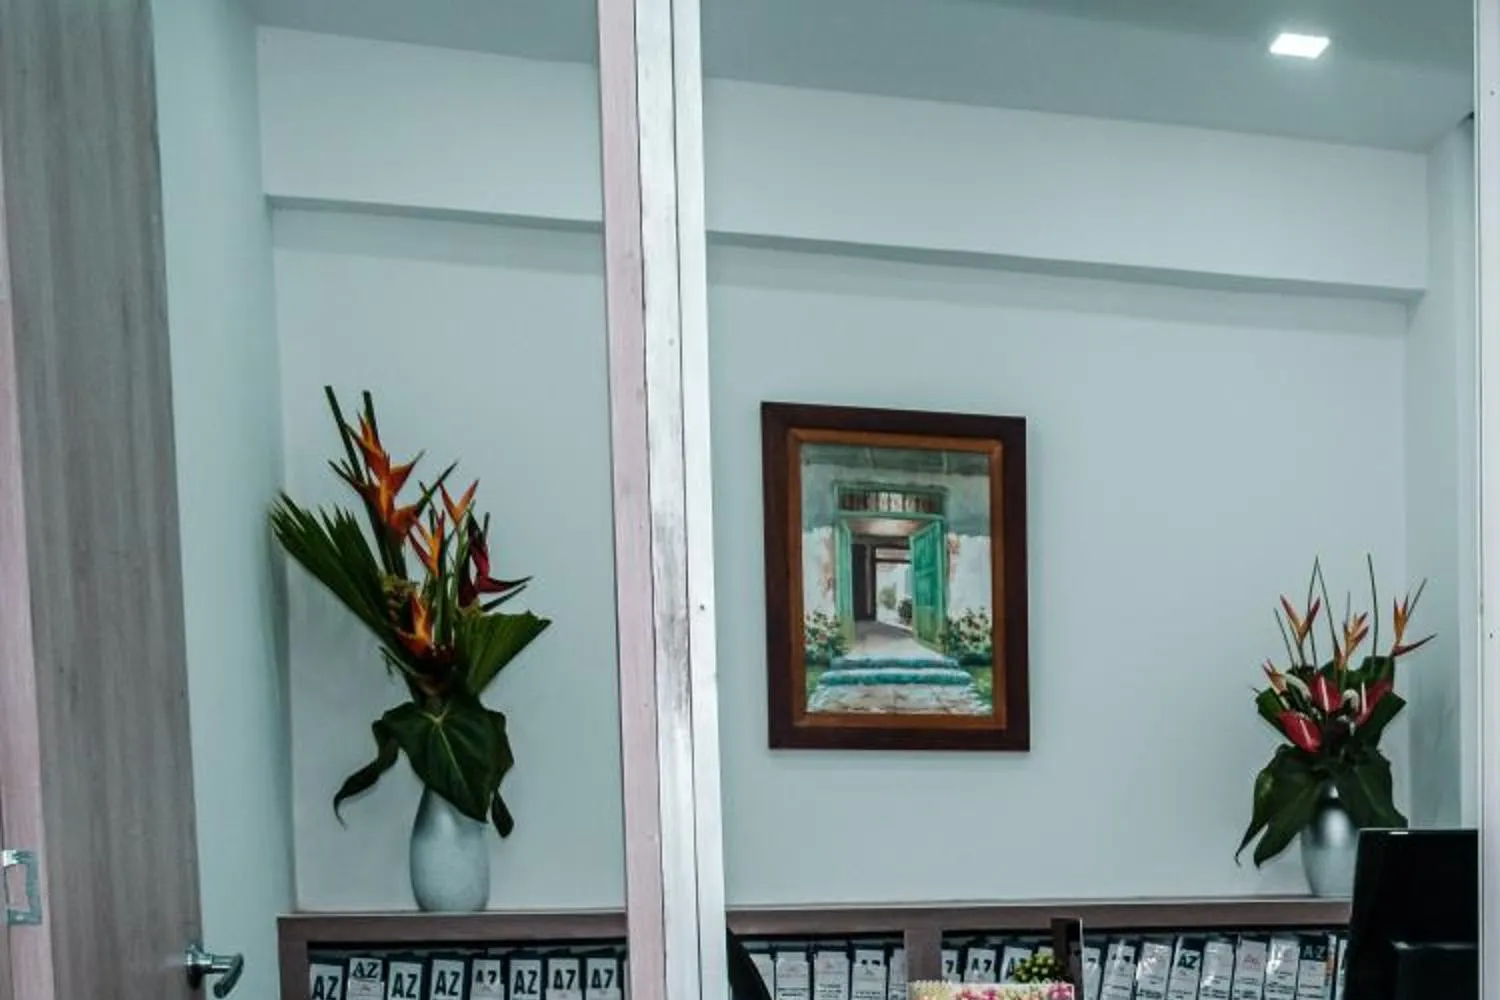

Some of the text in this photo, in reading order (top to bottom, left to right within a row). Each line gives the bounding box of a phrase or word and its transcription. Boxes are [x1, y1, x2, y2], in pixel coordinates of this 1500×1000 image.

[352, 961, 379, 979] AZ
[434, 970, 461, 996] AZ
[513, 969, 538, 995] AZ
[312, 975, 339, 1000] AZ
[391, 972, 418, 999] AZ
